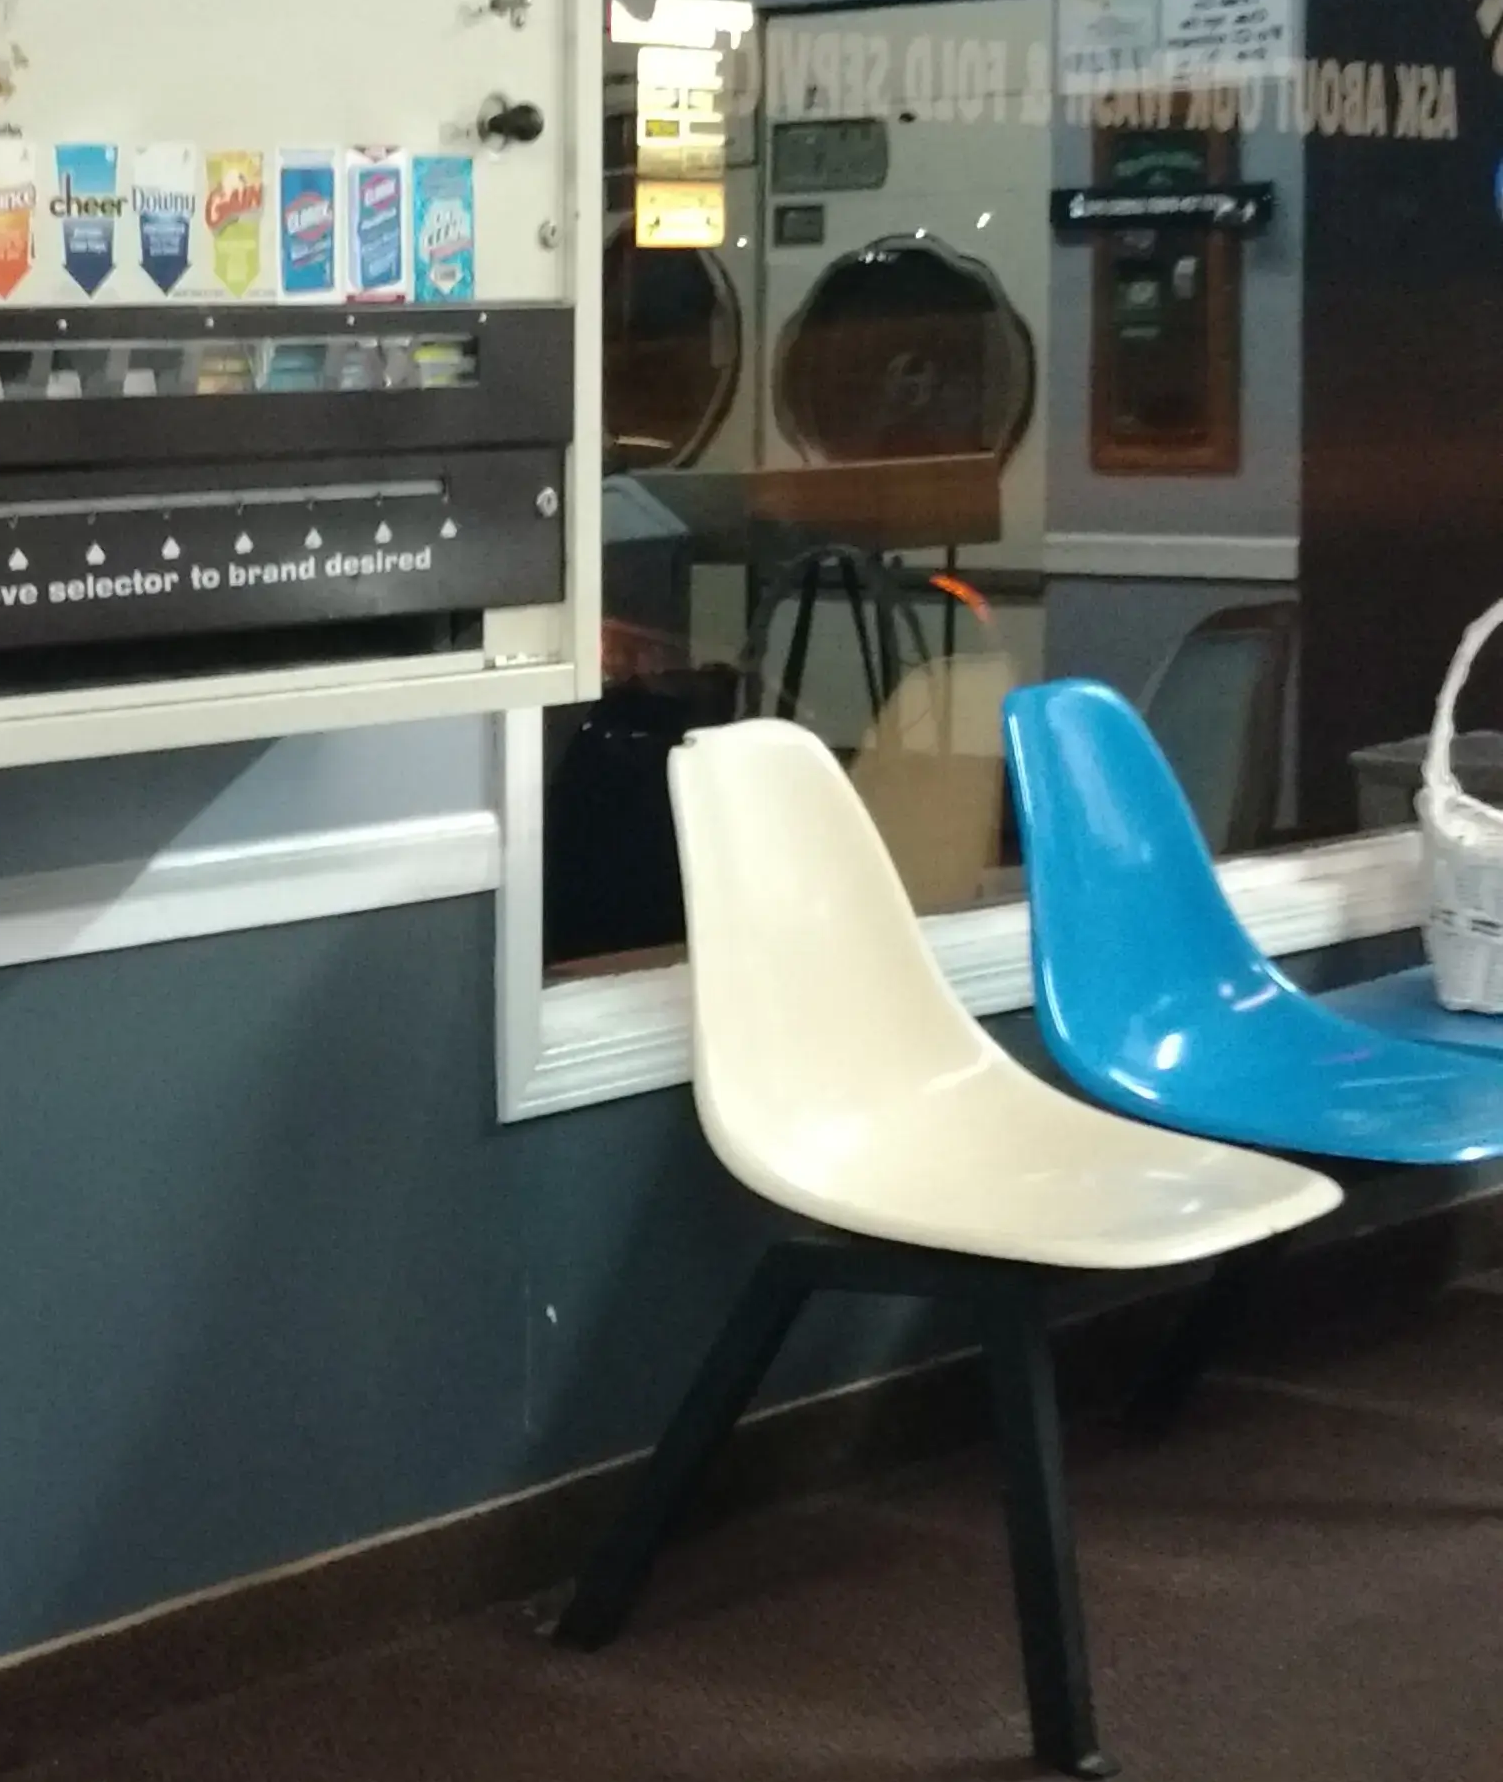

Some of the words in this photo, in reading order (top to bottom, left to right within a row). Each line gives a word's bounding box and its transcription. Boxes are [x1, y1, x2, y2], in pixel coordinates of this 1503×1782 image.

[49, 171, 129, 218] cheer
[132, 185, 196, 217] Downy
[48, 568, 180, 603] selector
[191, 564, 221, 591] to
[228, 556, 317, 587] brand
[325, 545, 433, 577] desired
